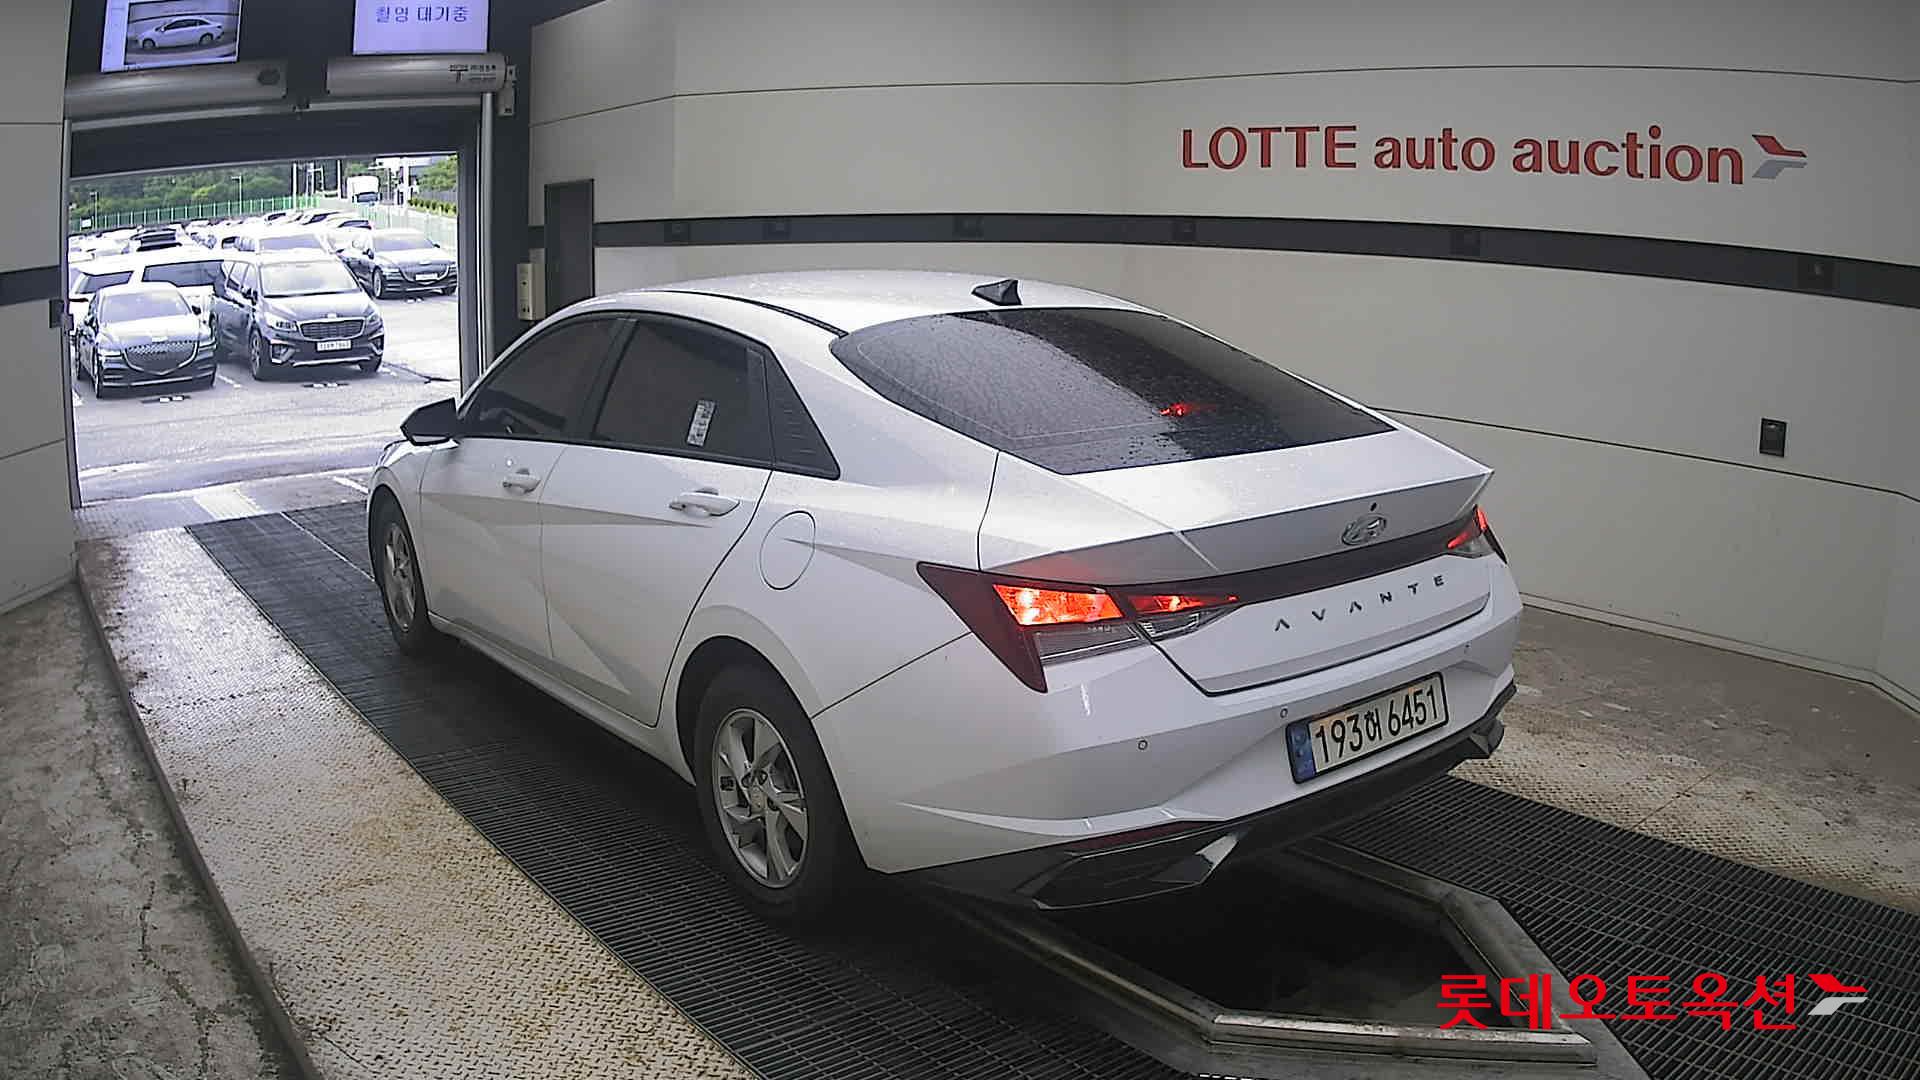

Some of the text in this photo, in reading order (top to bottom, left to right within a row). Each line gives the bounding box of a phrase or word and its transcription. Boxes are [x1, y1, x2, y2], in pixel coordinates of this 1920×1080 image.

[417, 5, 468, 23] 대기중
[1182, 125, 1743, 184] LOTTE auto auction
[1274, 574, 1446, 632] AVANTE
[1315, 707, 1382, 763] 193허
[1388, 684, 1438, 737] 6451
